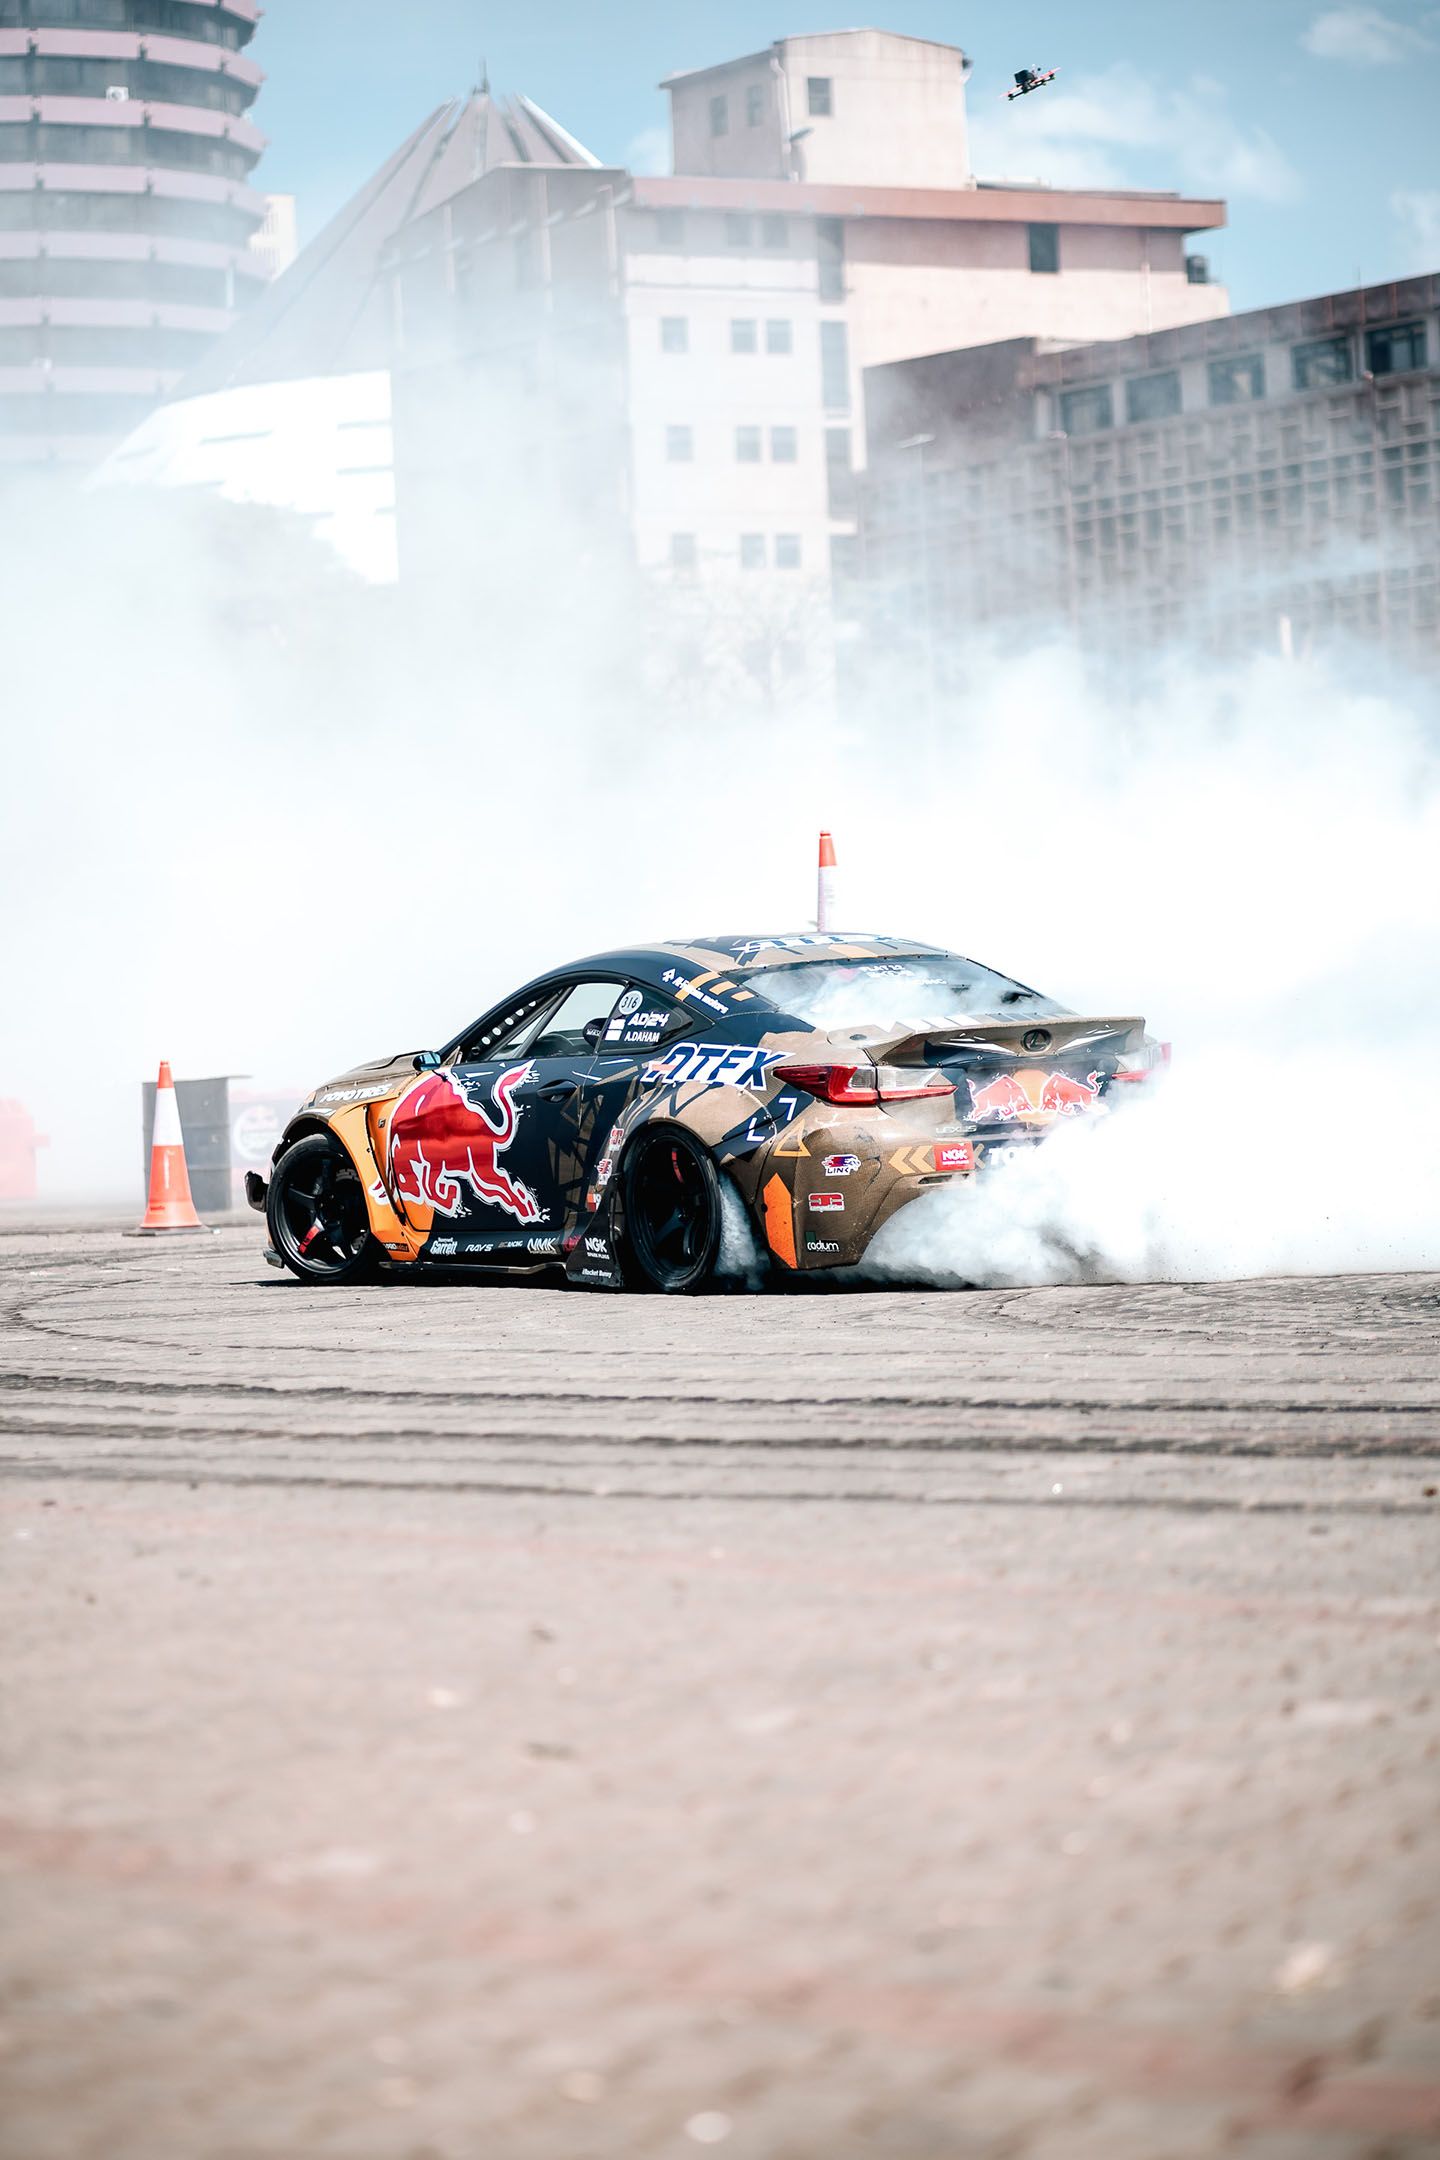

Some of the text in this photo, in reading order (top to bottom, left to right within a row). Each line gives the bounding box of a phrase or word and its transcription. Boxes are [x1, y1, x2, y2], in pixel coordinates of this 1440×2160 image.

[621, 996, 638, 1009] 316
[942, 1149, 968, 1160] NGK
[430, 1240, 457, 1256] Garrett
[465, 1244, 493, 1252] RAYS
[527, 1238, 557, 1252] NMK
[585, 1237, 607, 1253] NGK
